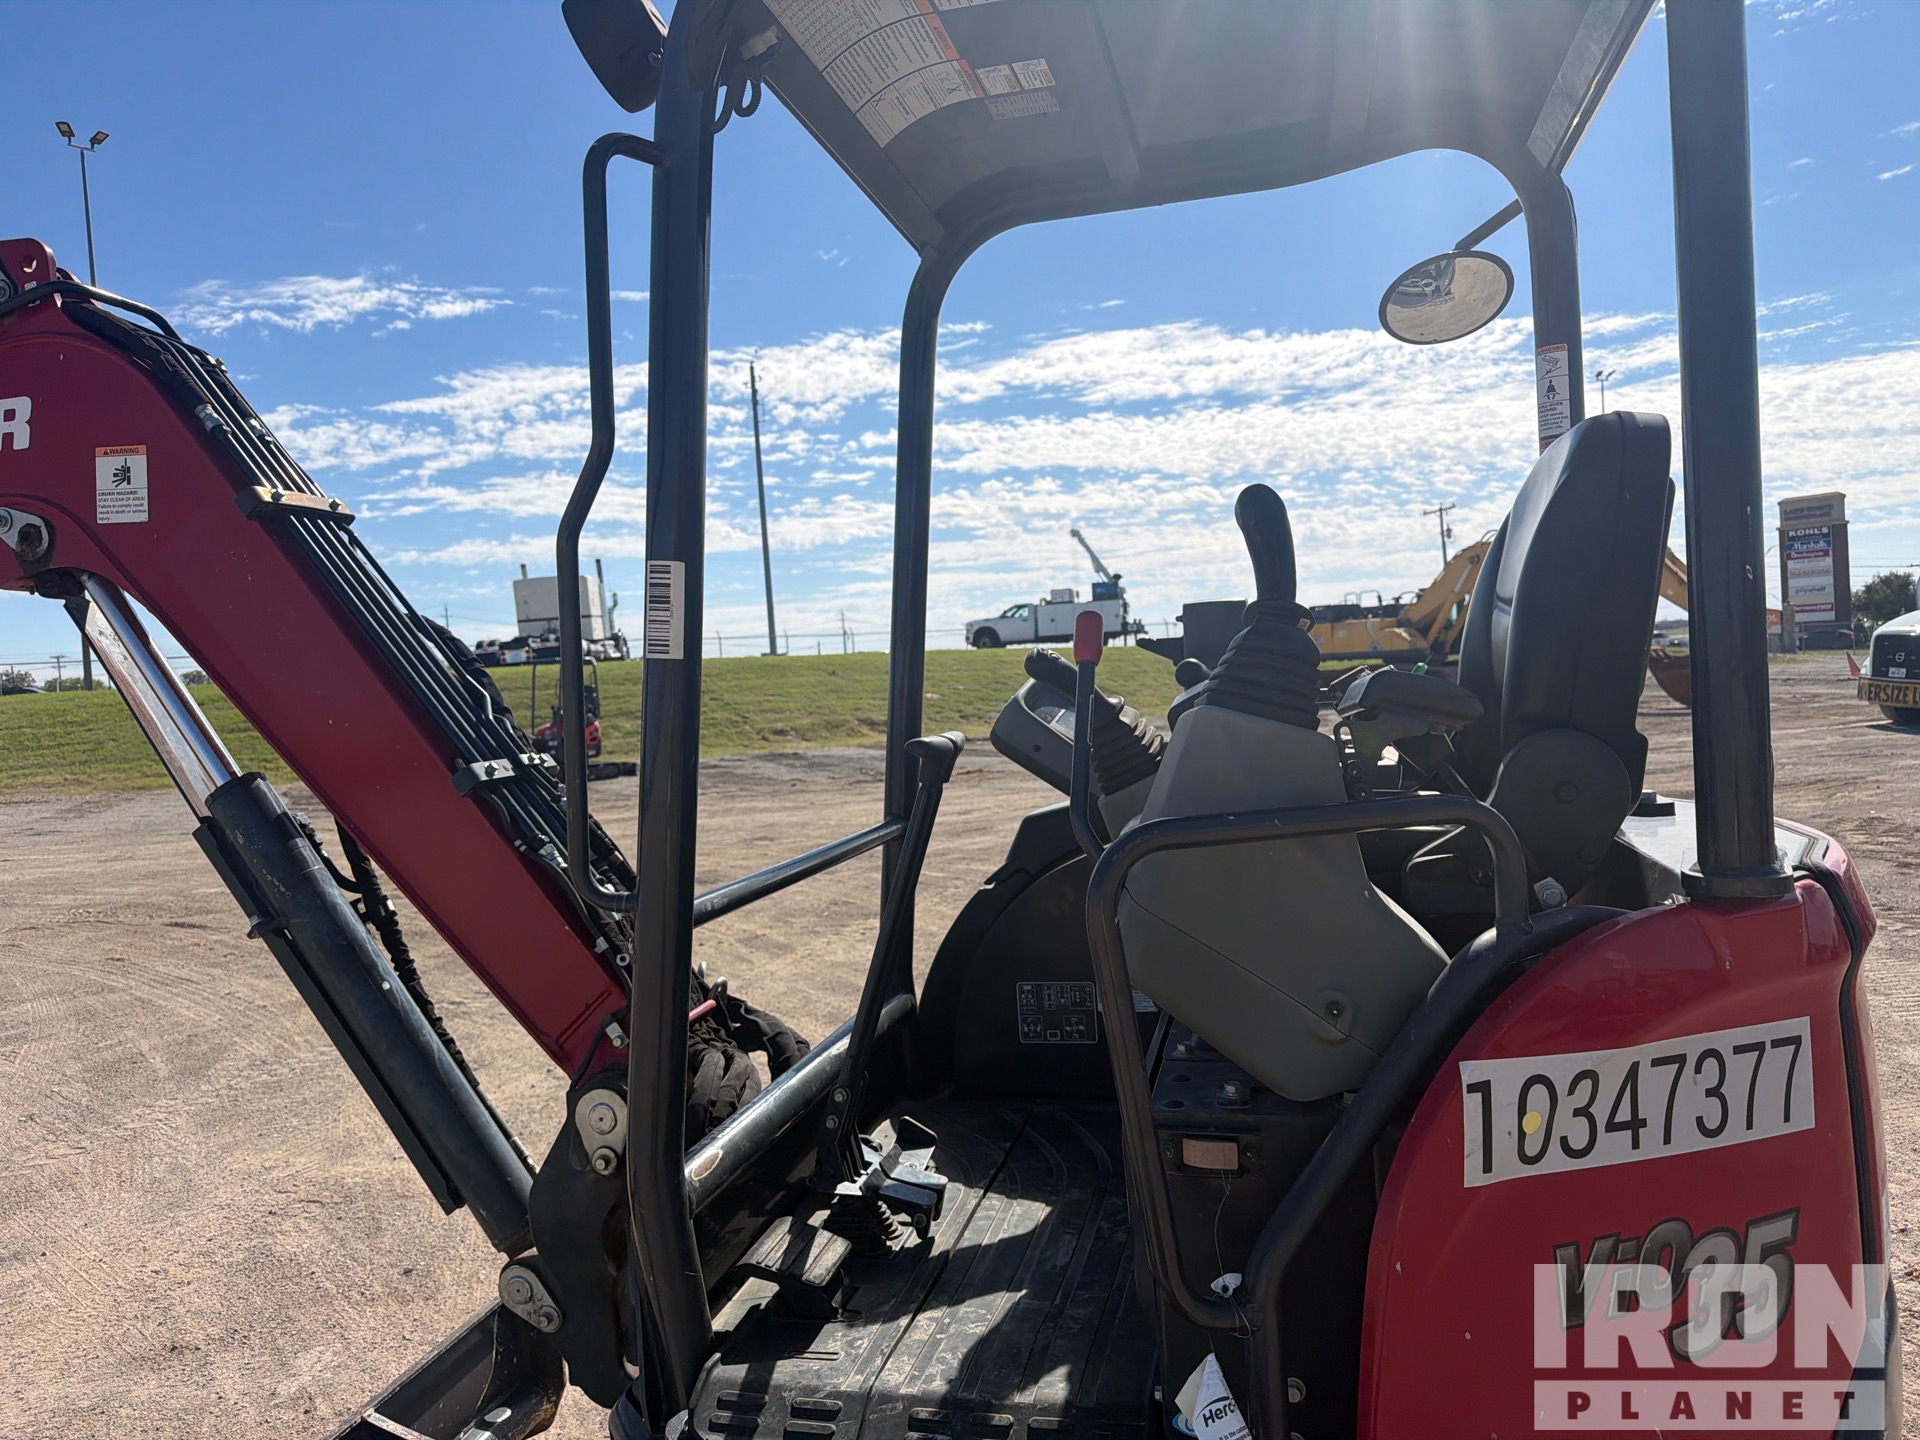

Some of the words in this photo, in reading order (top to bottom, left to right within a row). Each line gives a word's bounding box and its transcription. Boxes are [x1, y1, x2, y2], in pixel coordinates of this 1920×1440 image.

[109, 447, 139, 455] WARNING
[1788, 526, 1828, 537] KOHL'S
[1466, 1035, 1803, 1175] 10347377
